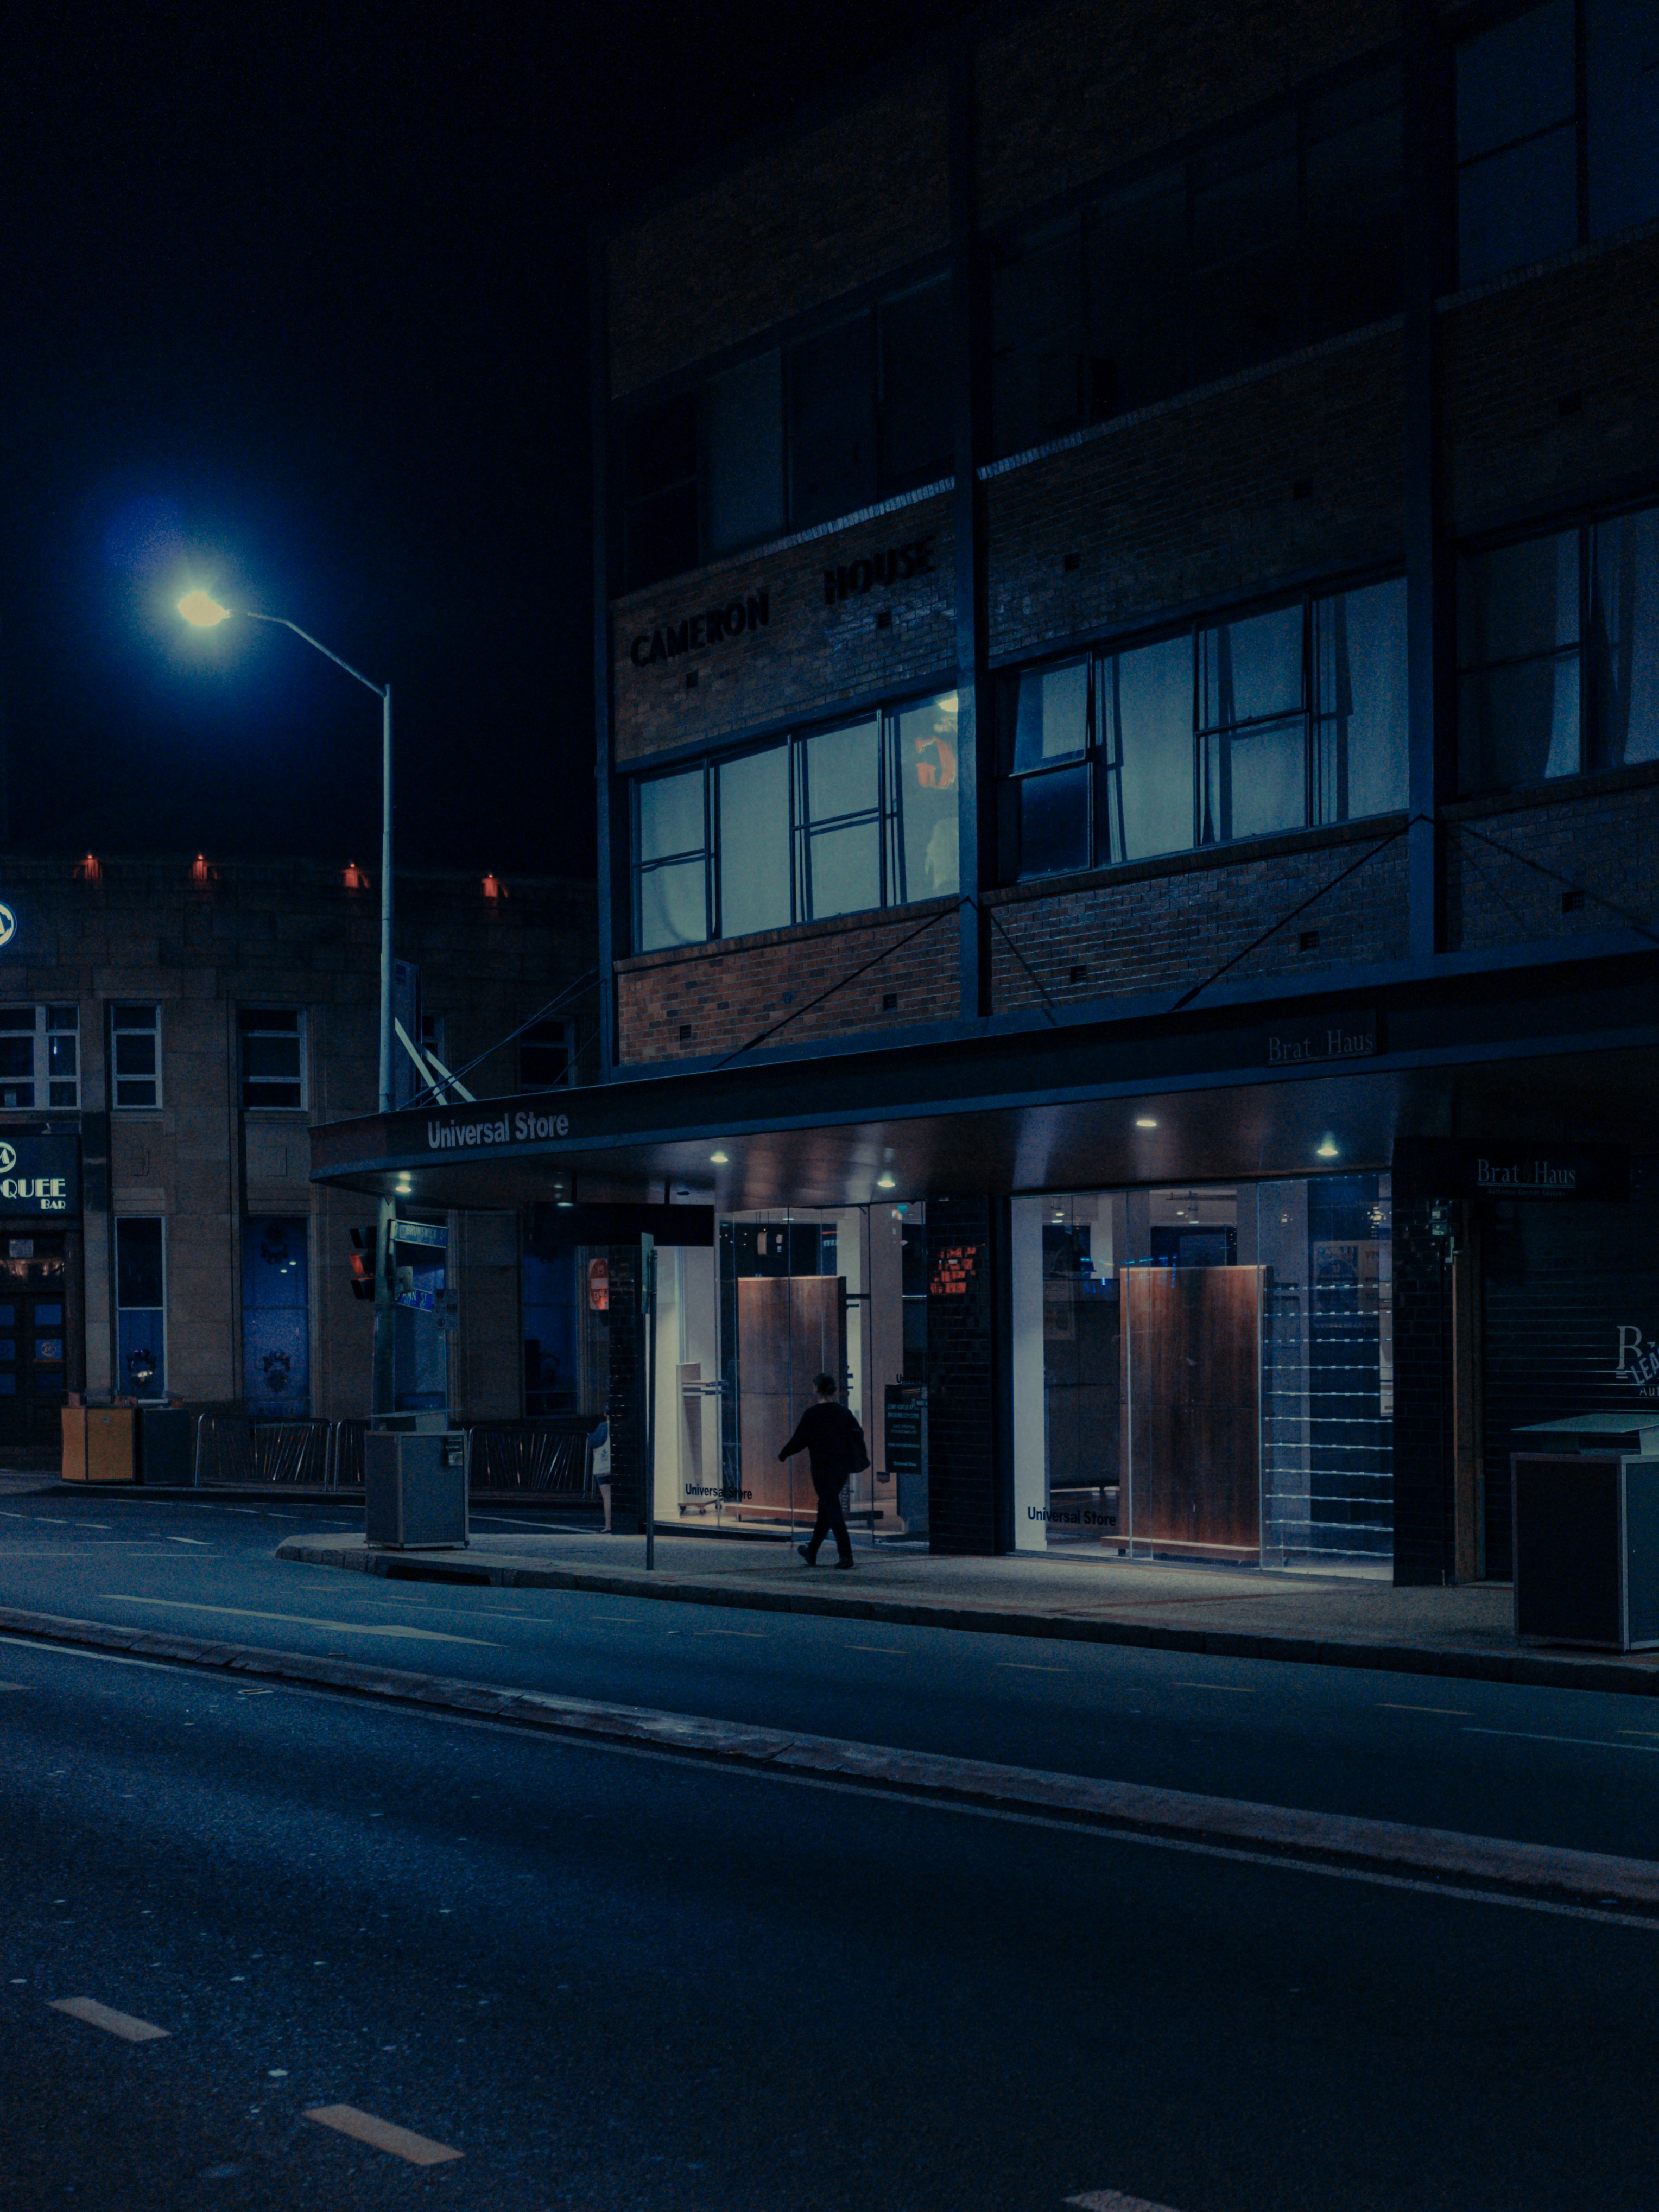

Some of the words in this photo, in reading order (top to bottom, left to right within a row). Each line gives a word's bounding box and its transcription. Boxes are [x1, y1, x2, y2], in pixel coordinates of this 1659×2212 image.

[630, 591, 769, 667] CAMERON
[824, 536, 936, 605] HOUSE
[1268, 1037, 1312, 1061] Brat
[1327, 1030, 1373, 1055] Haus
[427, 1113, 510, 1149] Universal
[515, 1111, 569, 1140] Store
[1477, 1159, 1520, 1183] Brat
[1534, 1161, 1576, 1184] Haus
[1630, 1347, 1659, 1386] LEA
[686, 1483, 725, 1498] Universal
[729, 1486, 752, 1499] Store
[1028, 1506, 1080, 1524] Universal
[1084, 1510, 1117, 1526] Store
